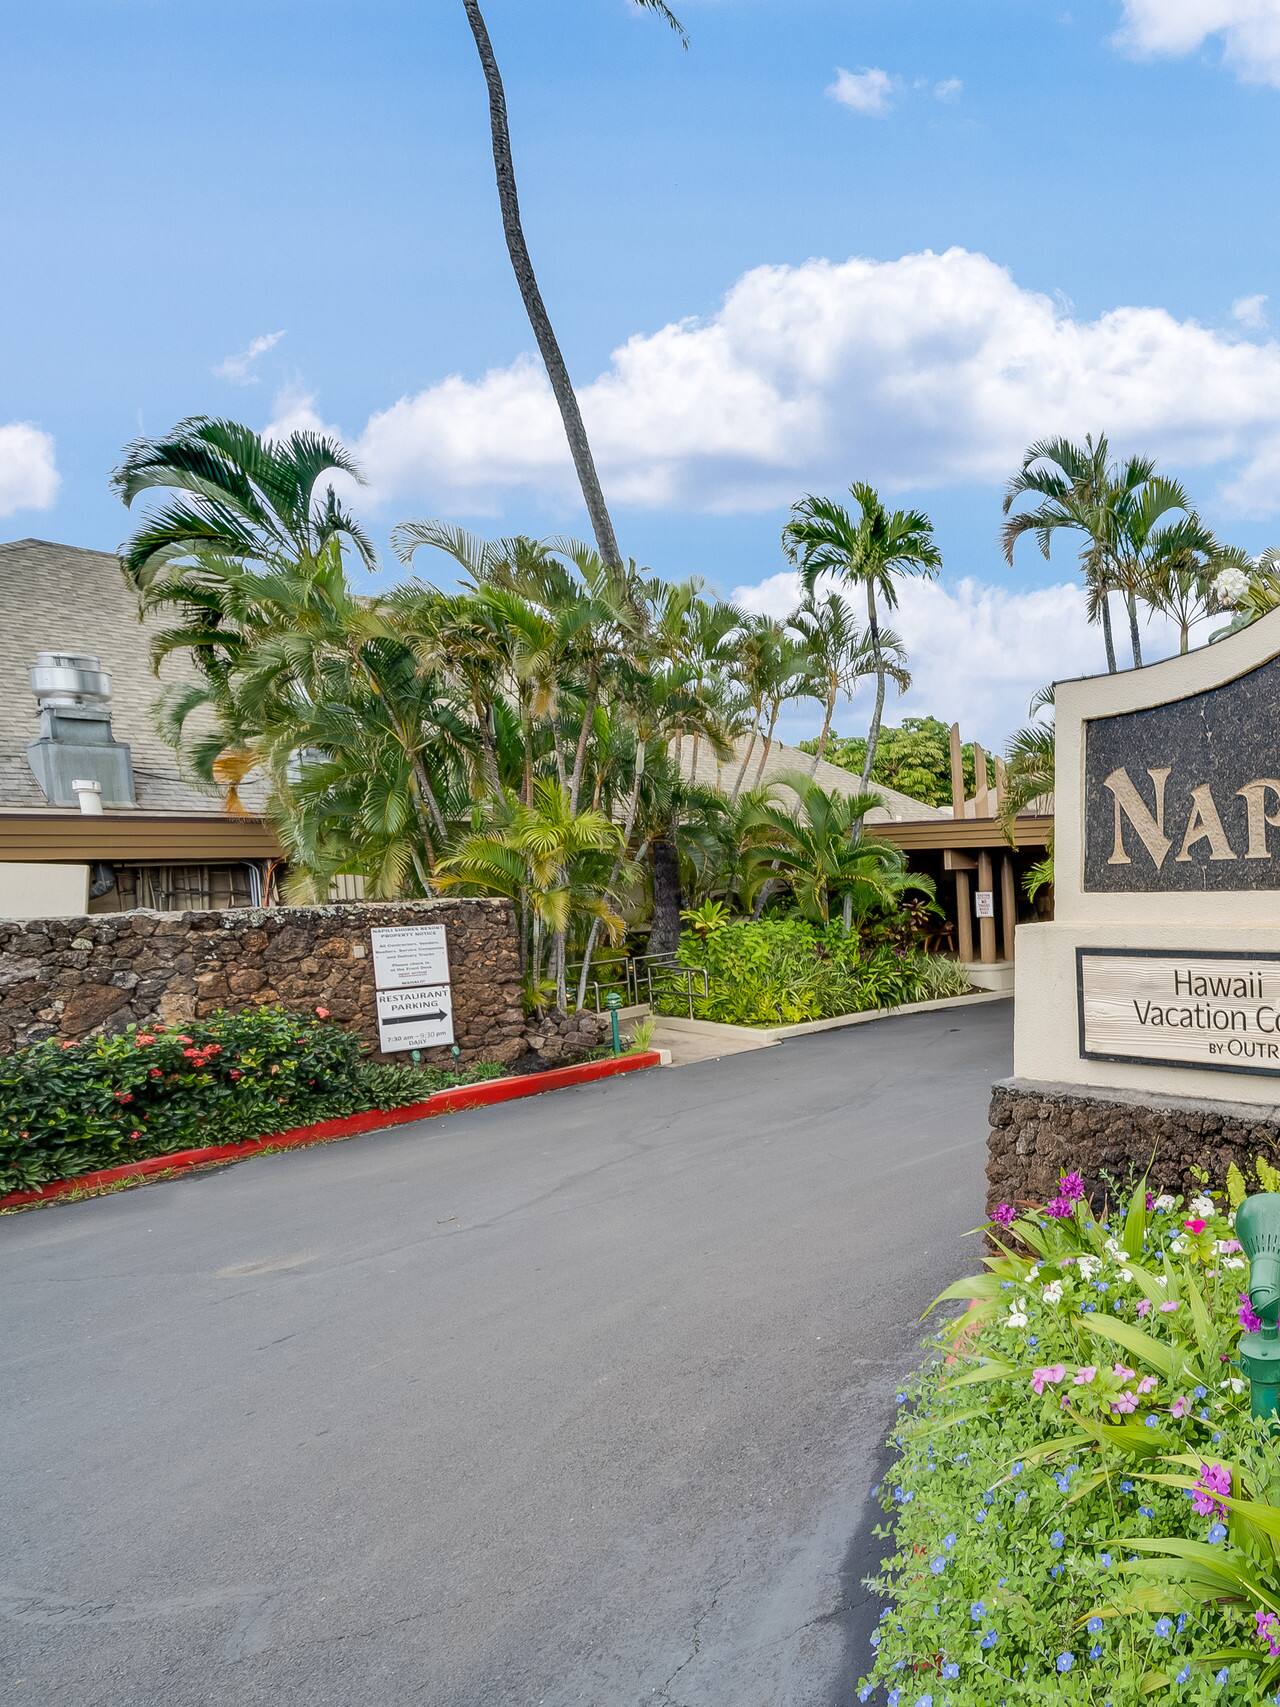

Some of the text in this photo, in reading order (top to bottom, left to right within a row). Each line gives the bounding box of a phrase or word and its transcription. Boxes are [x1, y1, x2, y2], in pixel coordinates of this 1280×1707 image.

[1174, 969, 1263, 999] Hawaii
[379, 990, 449, 1003] RESTAURANT
[391, 1000, 439, 1011] PARKING
[1133, 999, 1248, 1032] Vacation
[408, 1038, 427, 1046] DAILY
[1209, 1042, 1225, 1055] BY
